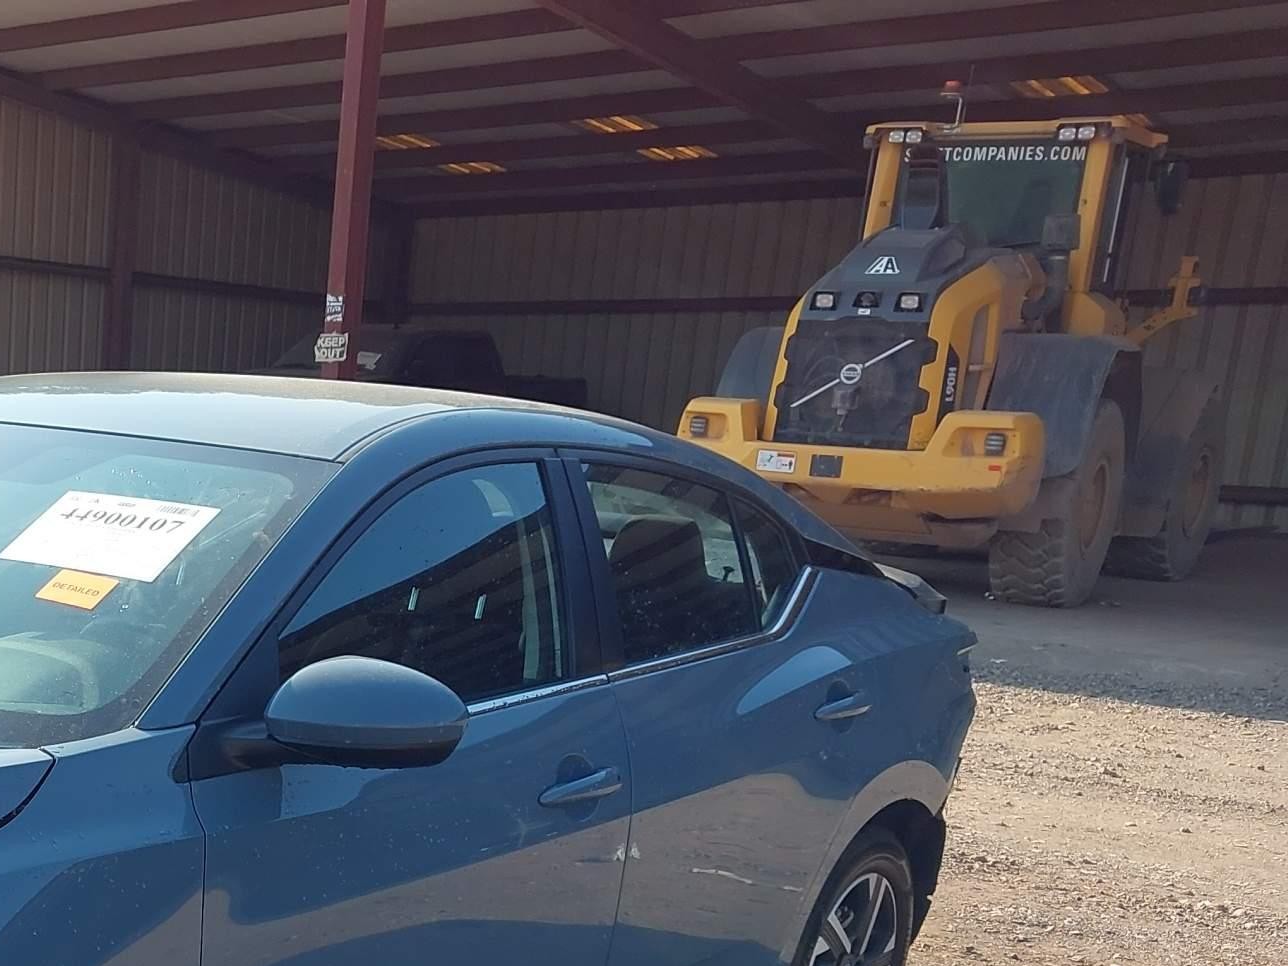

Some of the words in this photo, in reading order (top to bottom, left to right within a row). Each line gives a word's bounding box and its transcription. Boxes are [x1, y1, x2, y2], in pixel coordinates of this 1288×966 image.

[904, 146, 1087, 162] STCOMPANIES.COM
[317, 336, 345, 348] KEEP
[320, 348, 345, 358] OUT
[945, 366, 958, 403] L90H
[61, 507, 186, 534] 44900107
[52, 581, 100, 597] DETAILED
